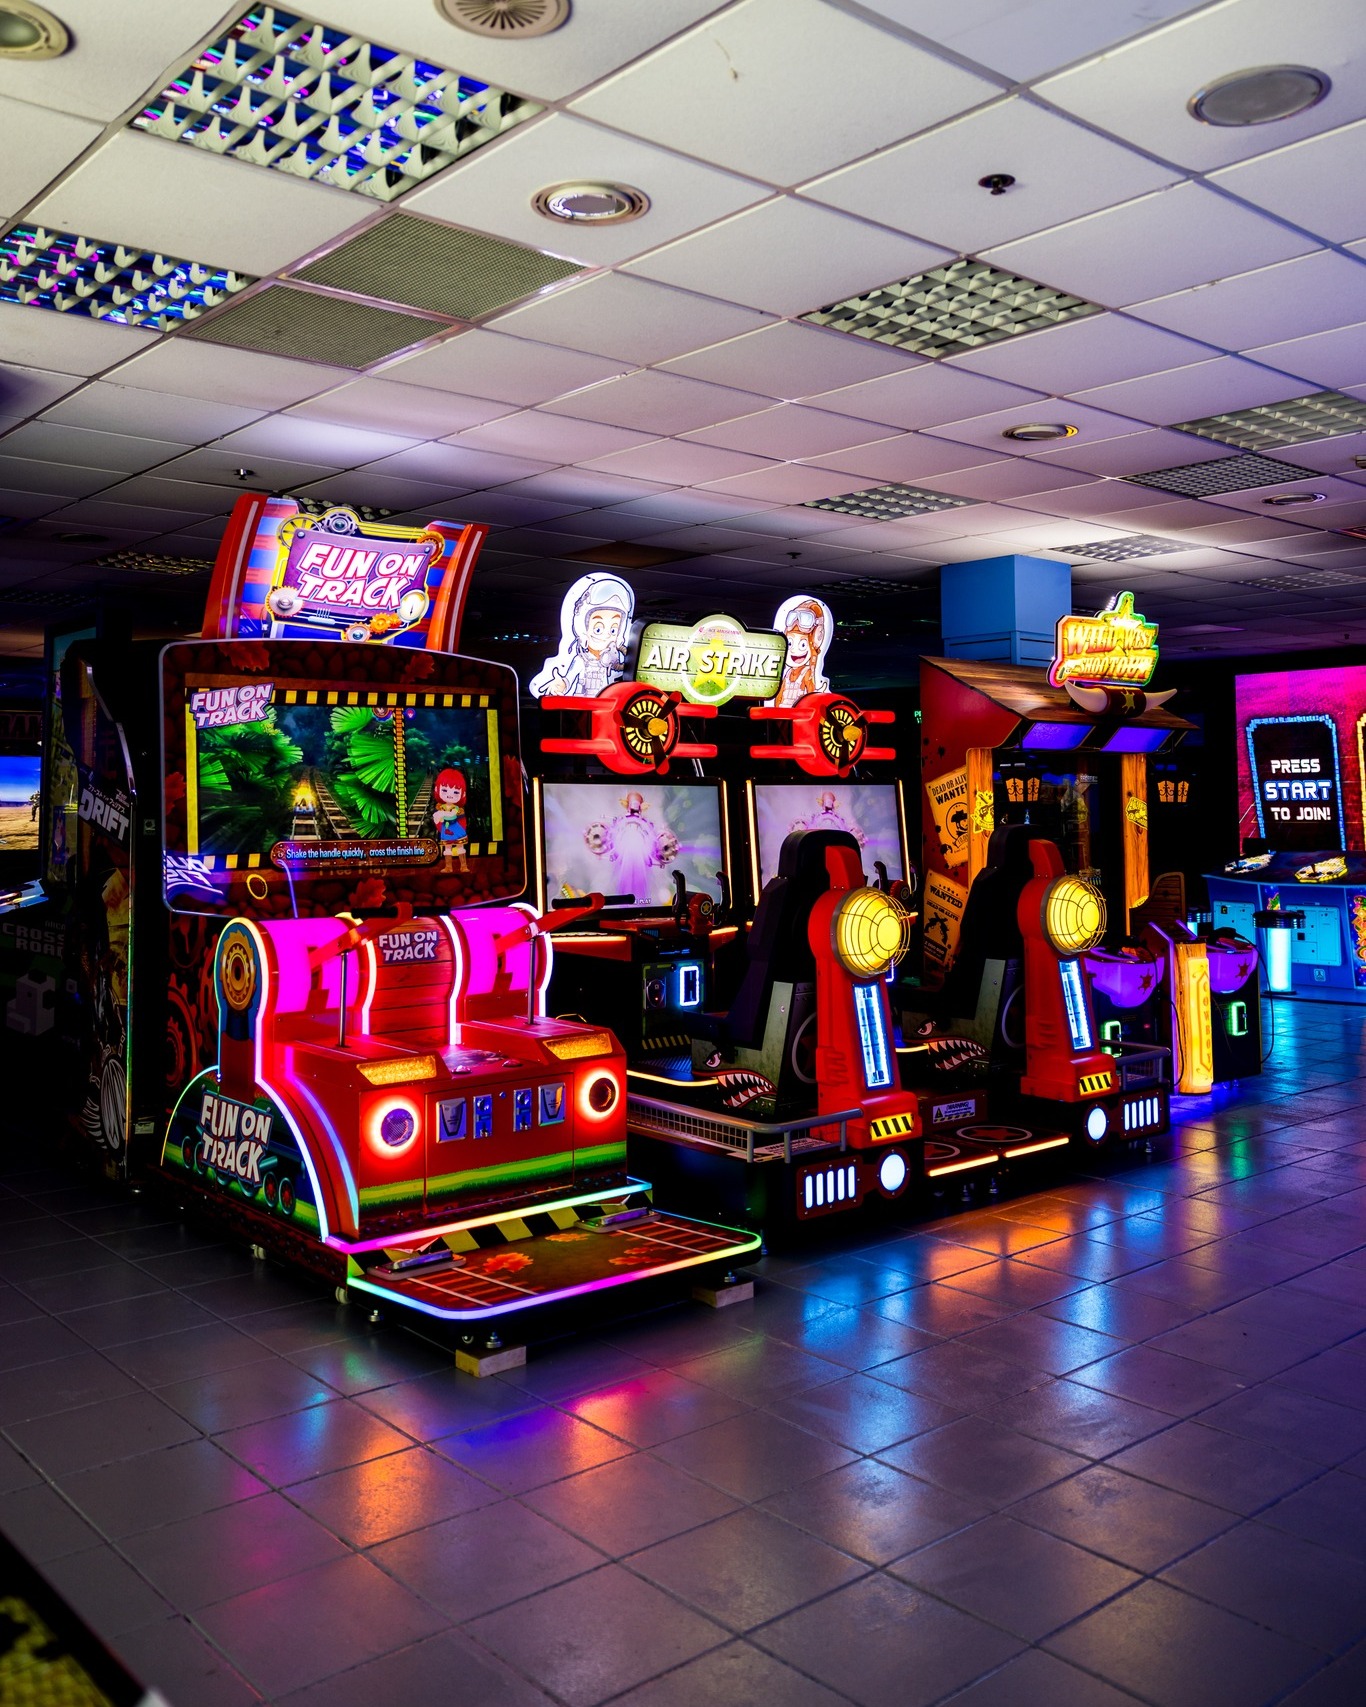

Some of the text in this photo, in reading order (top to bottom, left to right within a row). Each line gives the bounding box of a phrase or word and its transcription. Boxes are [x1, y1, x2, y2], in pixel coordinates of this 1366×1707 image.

[299, 542, 426, 579] FUN ON
[298, 572, 408, 608] TRACK
[1067, 624, 1156, 655] WILD WEST
[642, 645, 781, 678] AIR STRIKE
[1079, 656, 1154, 678] SHOOTOUT
[192, 684, 272, 711] FUN ON
[196, 700, 266, 726] TRACK
[1270, 758, 1320, 774] PRESS
[954, 773, 967, 785] ALIV
[1265, 780, 1332, 800] START
[936, 783, 968, 805] WANTE
[78, 788, 129, 841] DRIFT
[1270, 807, 1331, 820] TO JOIN!
[286, 849, 307, 859] Shake
[308, 849, 319, 858] the
[320, 848, 341, 858] handle
[369, 849, 386, 857] cross
[386, 847, 396, 856] the
[396, 846, 413, 856] finish
[414, 846, 424, 855] line
[930, 885, 963, 909] WANTED
[379, 931, 437, 949] FUN ON
[383, 942, 435, 961] TRACK
[201, 1095, 271, 1144] FUN ON
[202, 1132, 263, 1182] TRACK
